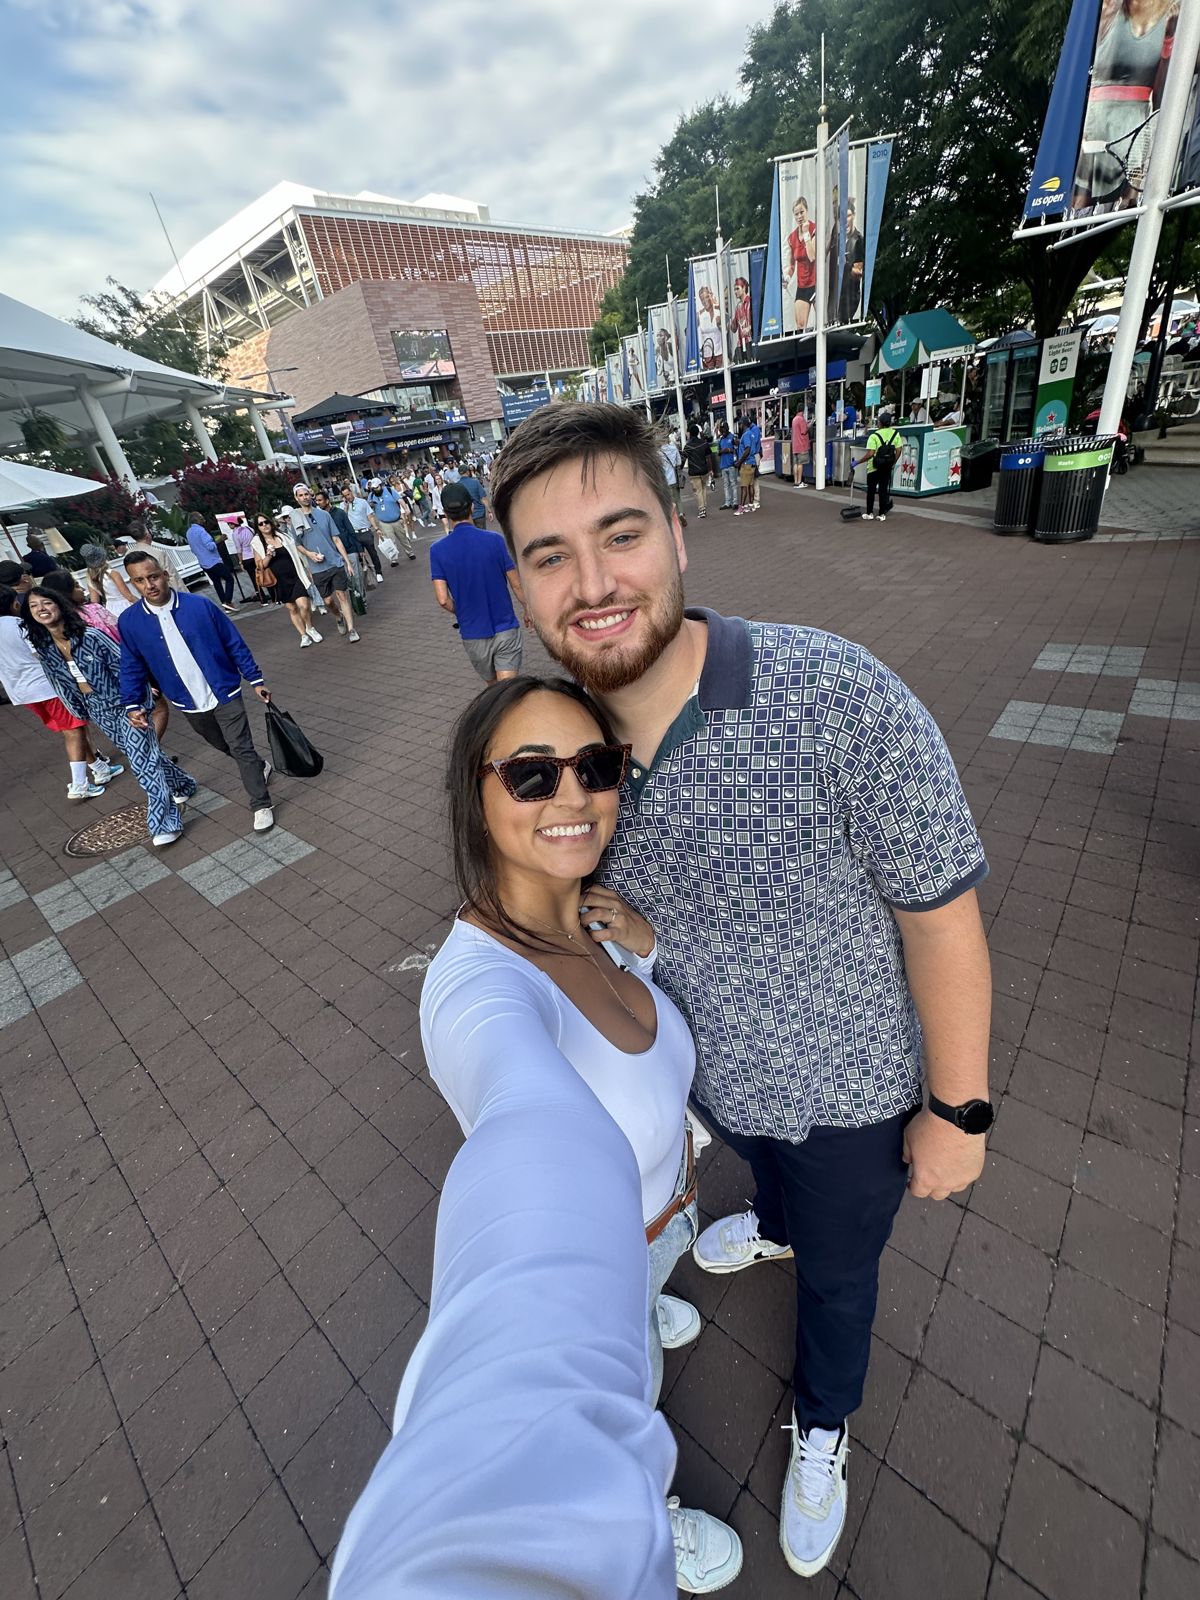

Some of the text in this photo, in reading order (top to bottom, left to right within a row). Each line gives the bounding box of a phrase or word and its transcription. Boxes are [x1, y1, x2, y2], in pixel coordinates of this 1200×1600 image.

[872, 149, 888, 159] 2010
[1031, 193, 1065, 207] us open
[403, 439, 417, 448] open
[417, 434, 443, 445] essentials
[330, 447, 364, 461] essetials
